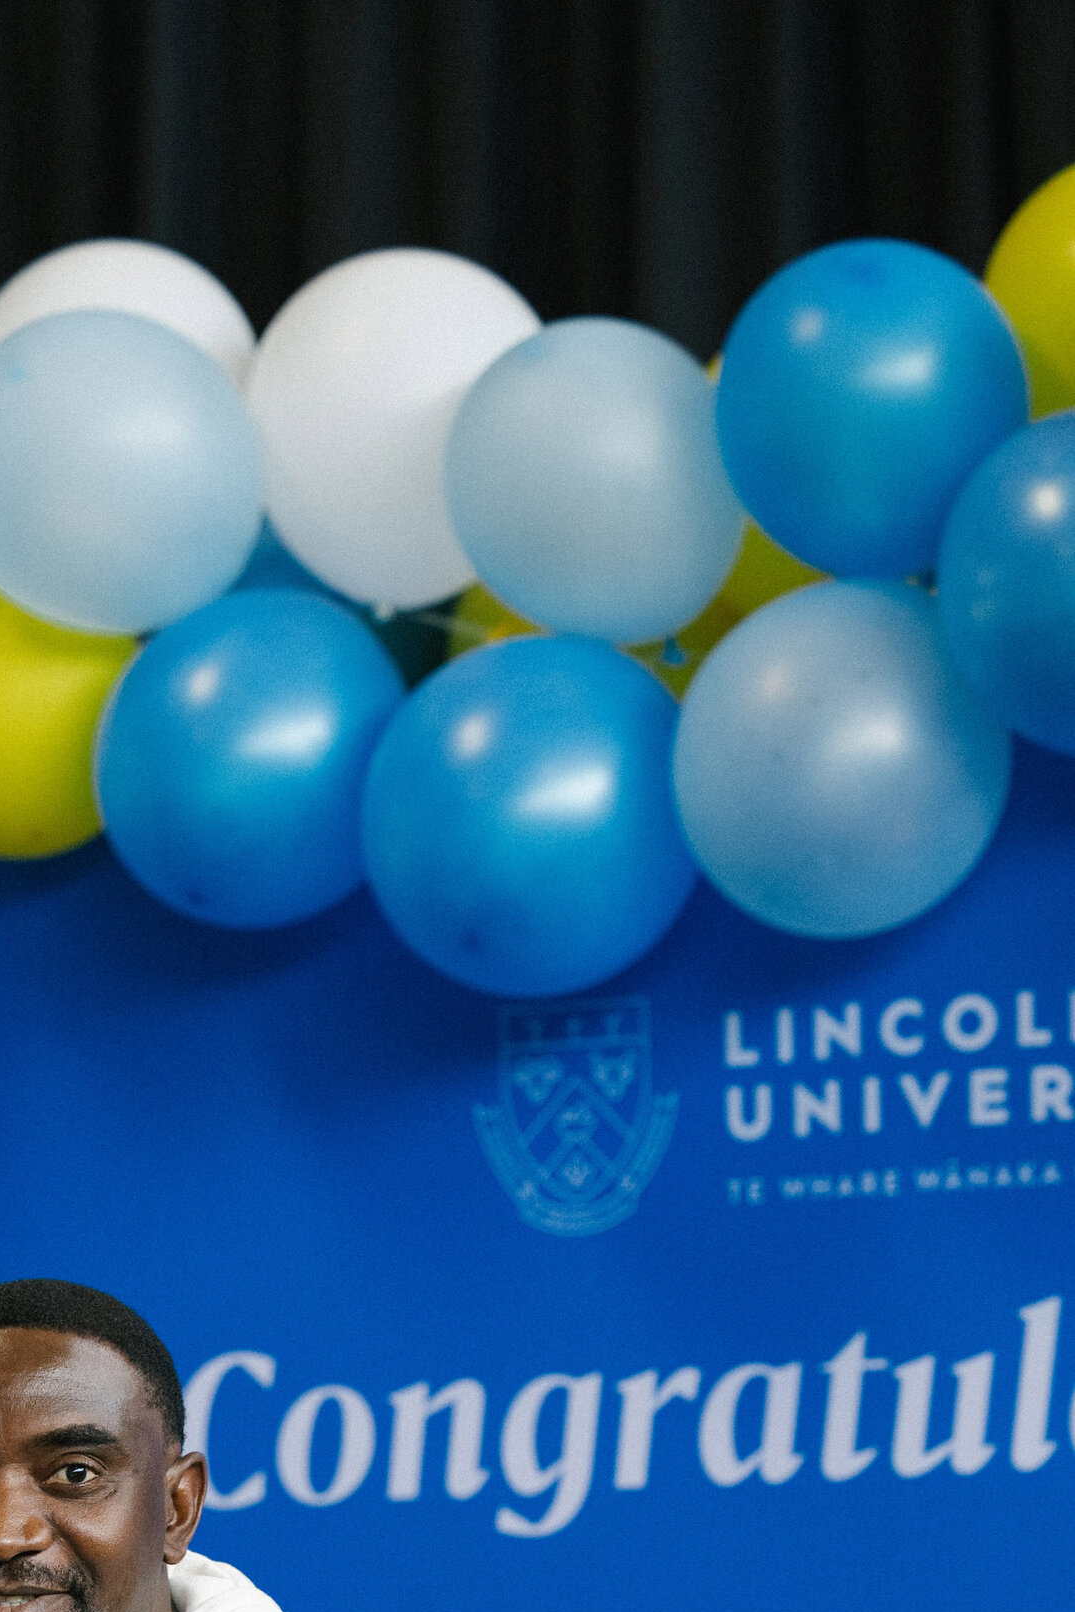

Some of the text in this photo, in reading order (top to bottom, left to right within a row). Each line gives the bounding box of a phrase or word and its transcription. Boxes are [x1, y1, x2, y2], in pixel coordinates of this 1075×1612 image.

[725, 988, 1075, 1068] LINCOL
[726, 1064, 1075, 1142] UNIVER
[181, 1294, 1075, 1538] Congratul
